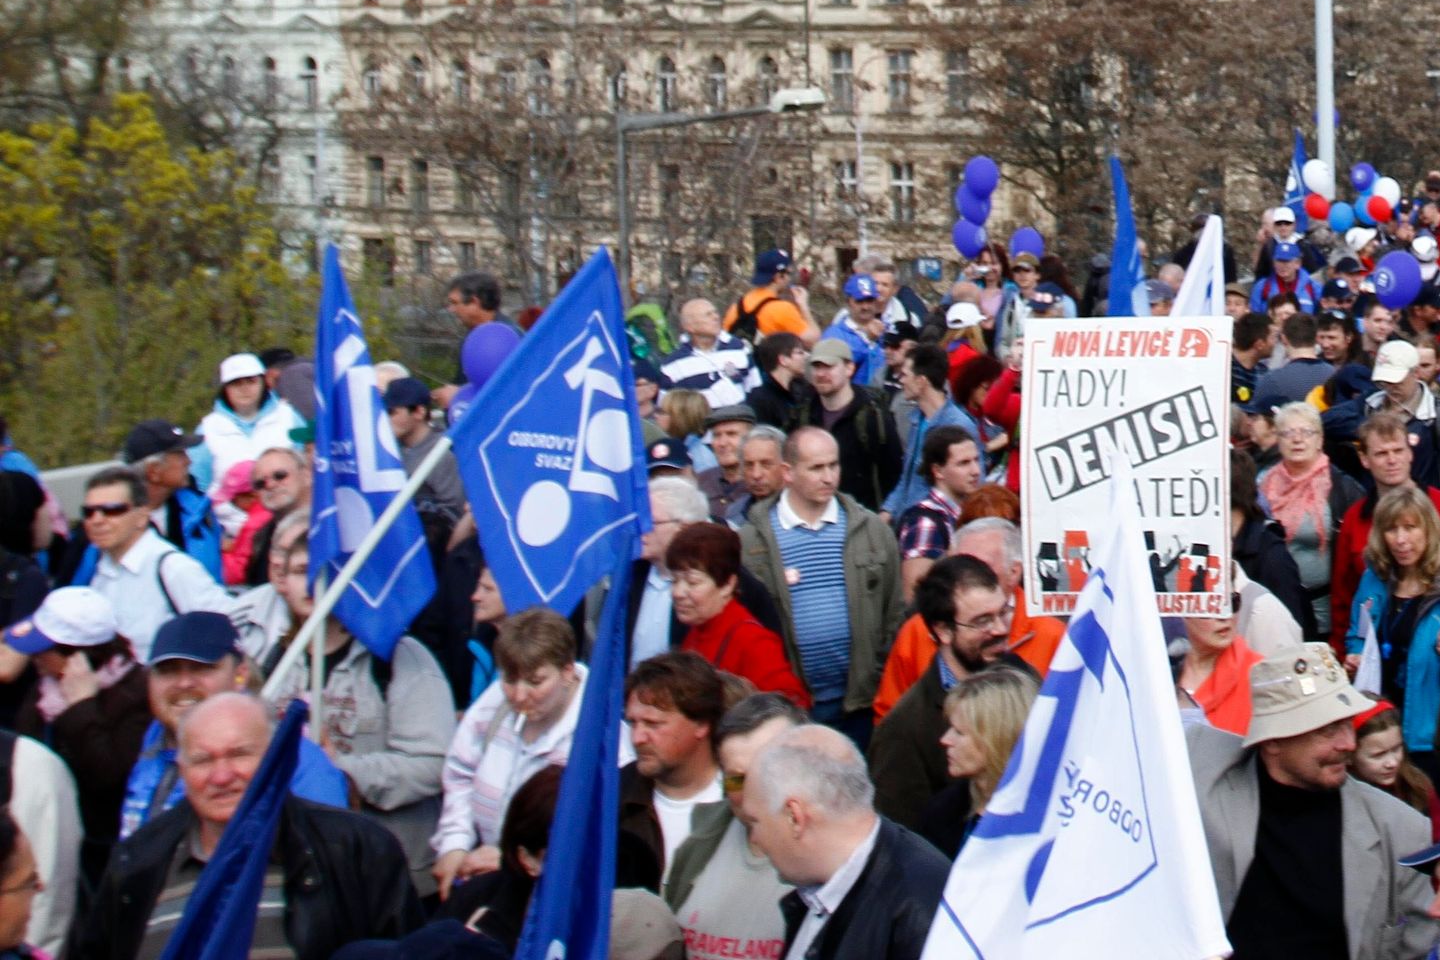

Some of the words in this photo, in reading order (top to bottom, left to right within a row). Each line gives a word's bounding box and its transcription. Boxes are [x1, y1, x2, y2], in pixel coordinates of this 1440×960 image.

[1051, 325, 1101, 358] NOVÁ
[1103, 330, 1175, 358] LEVICE
[1037, 368, 1127, 408] TADY!
[1037, 389, 1216, 499] DEMISI!
